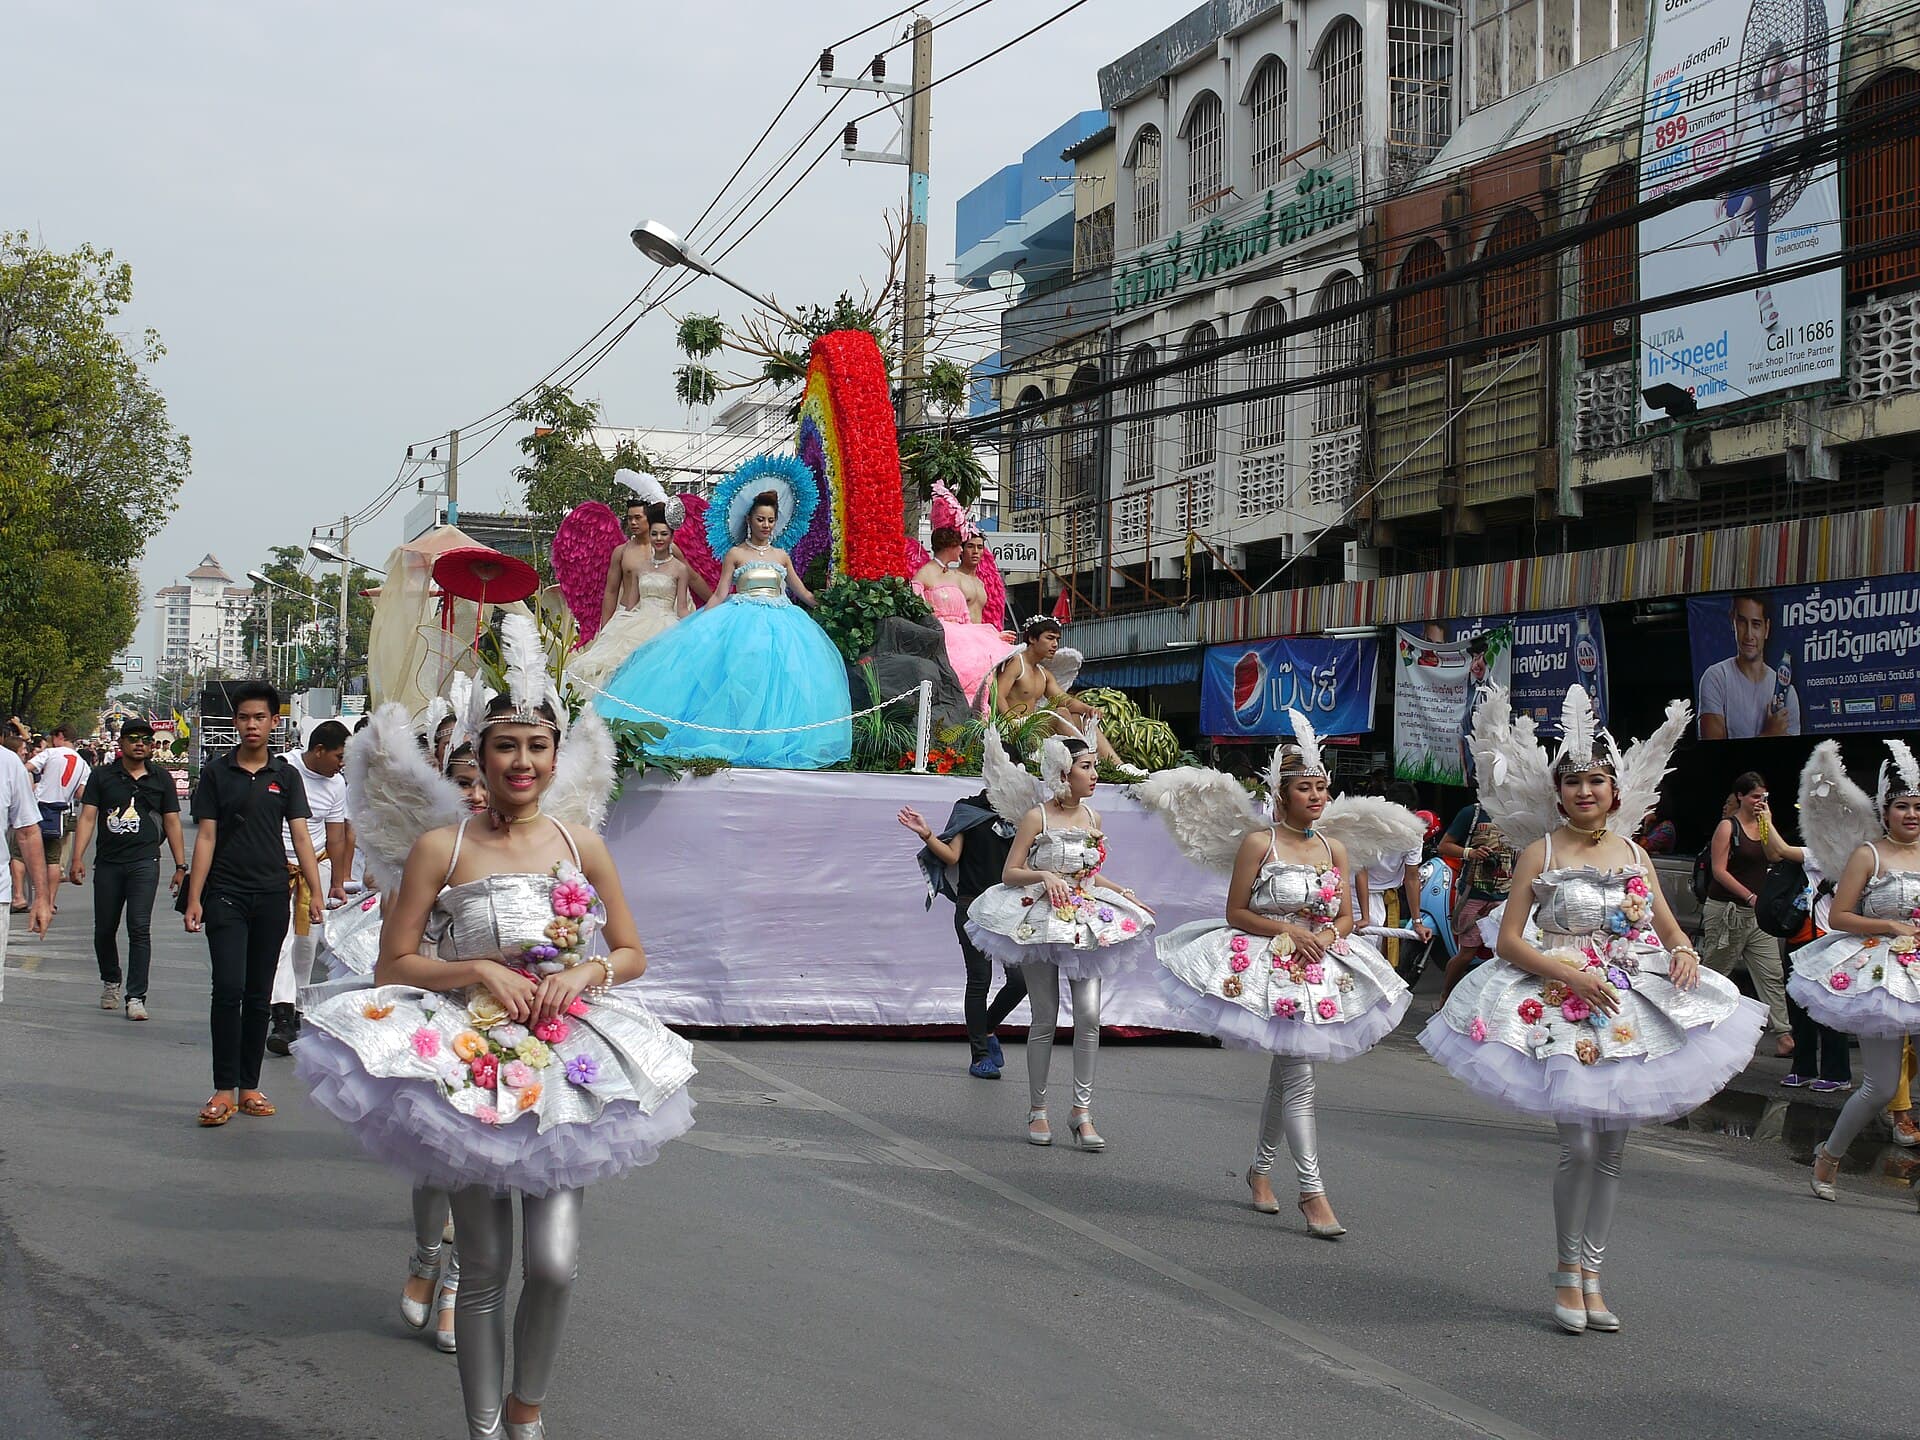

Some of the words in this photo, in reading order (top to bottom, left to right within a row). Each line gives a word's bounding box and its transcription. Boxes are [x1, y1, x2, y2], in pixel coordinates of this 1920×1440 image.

[1651, 75, 1684, 122] 15
[1655, 115, 1688, 148] 899
[1649, 326, 1684, 349] ULTRA
[1767, 327, 1794, 352] Call
[1798, 319, 1834, 344] 1686
[1648, 330, 1728, 377] hi-speed
[1748, 361, 1764, 372] True
[1765, 355, 1784, 367] Shop
[1789, 350, 1806, 362] True
[1808, 344, 1835, 357] Partner
[1748, 358, 1835, 385] www.trueonline.com
[1696, 378, 1728, 398] online
[992, 542, 1037, 561] คลีนิค
[1782, 580, 1920, 627] เครื่องดื่มแม
